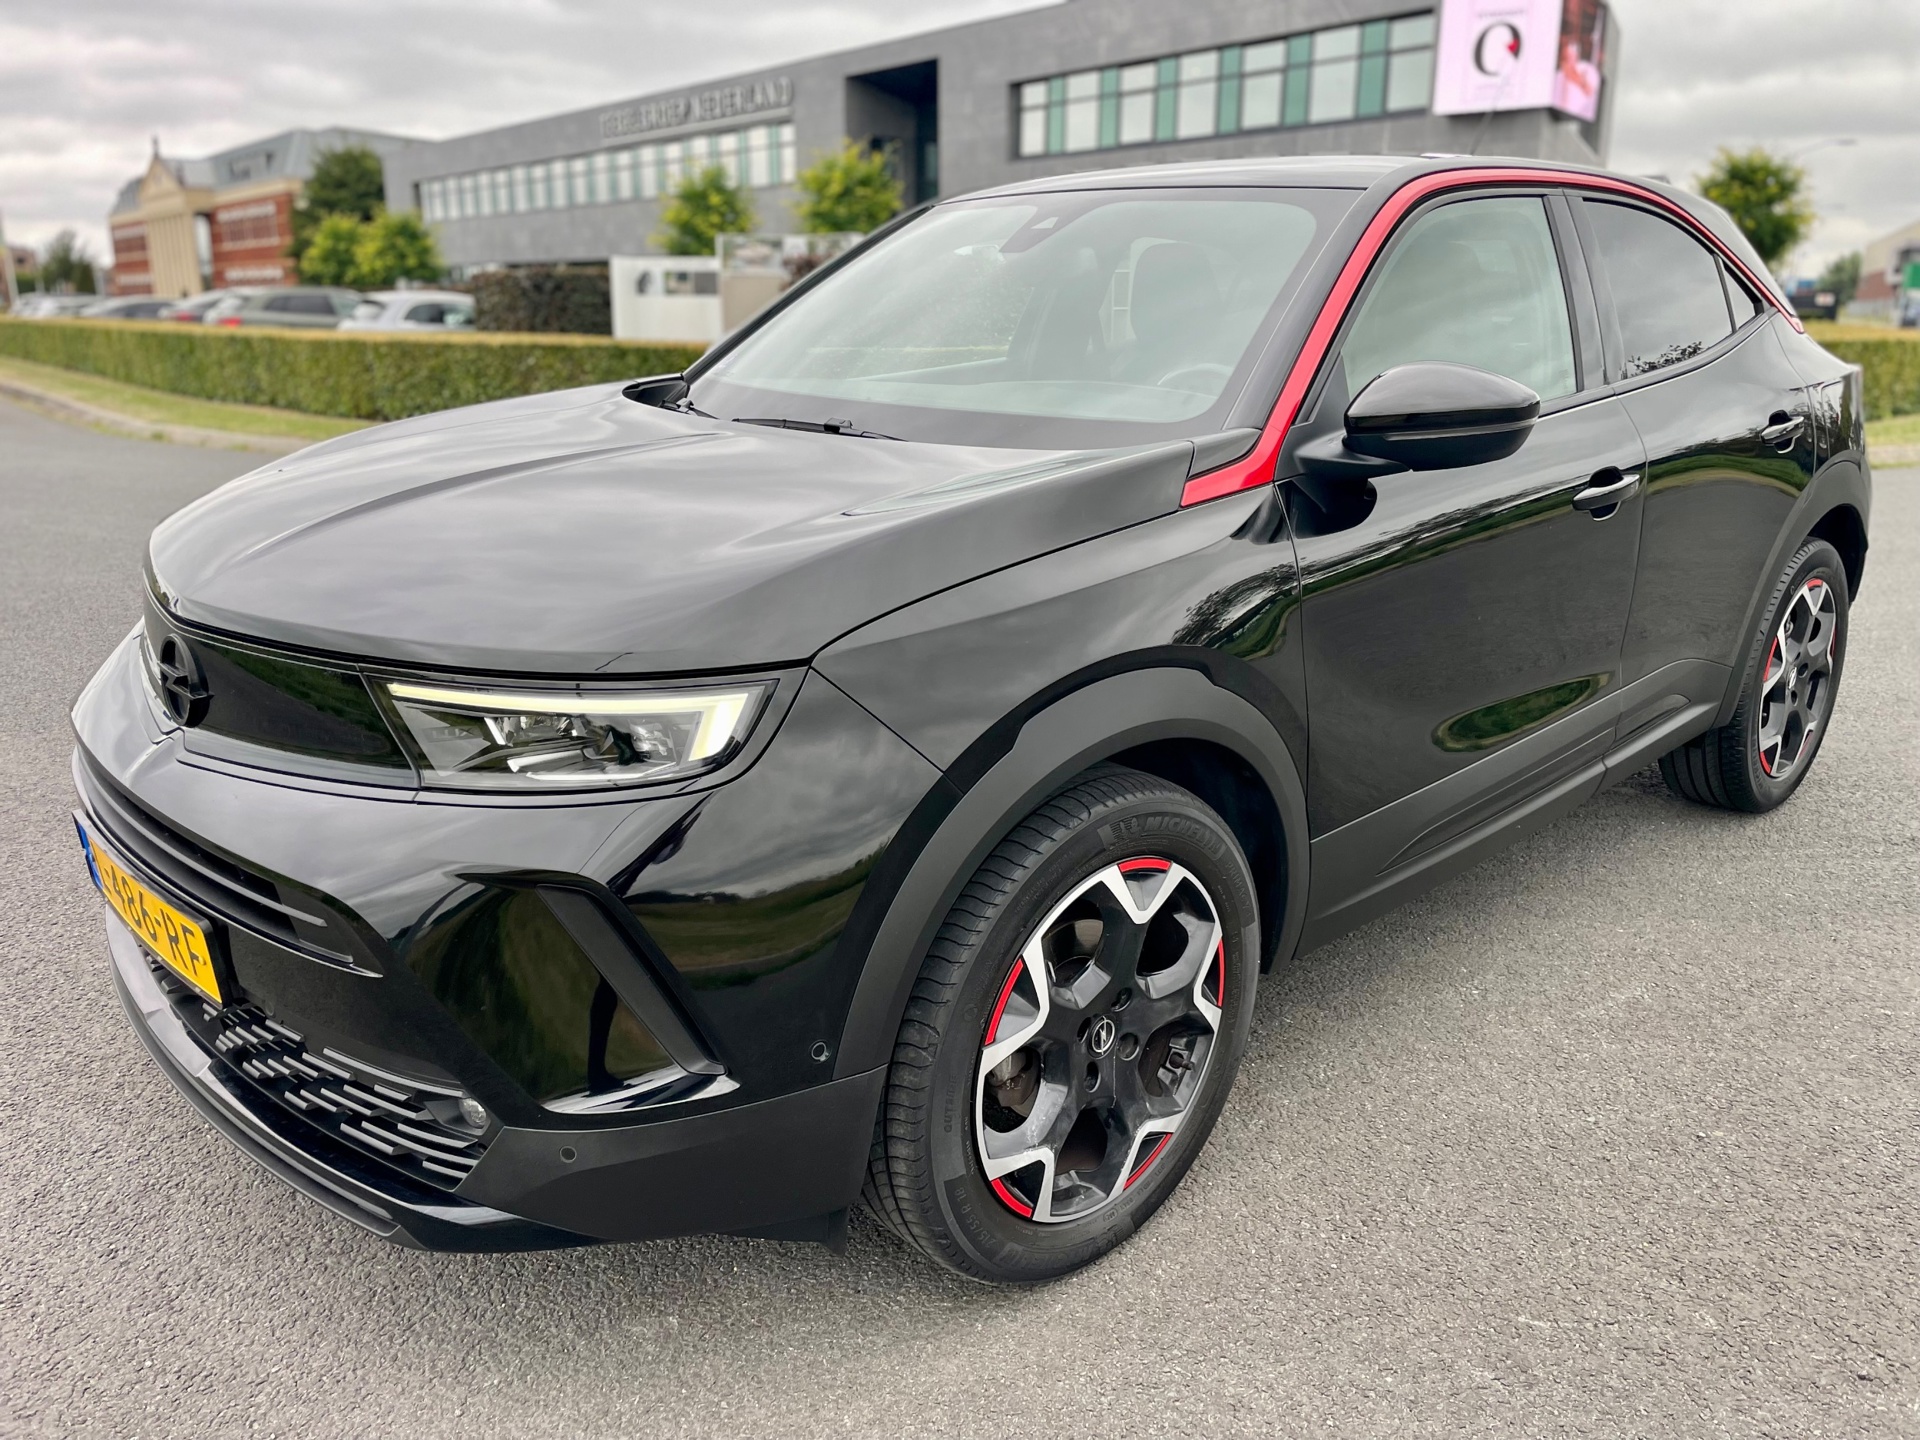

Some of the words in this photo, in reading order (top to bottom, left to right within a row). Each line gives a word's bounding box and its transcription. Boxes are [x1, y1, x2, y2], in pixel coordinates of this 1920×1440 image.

[1144, 816, 1220, 855] MICHELIN
[1226, 862, 1251, 909] PRIMACY
[954, 1186, 964, 1201] 18
[962, 1204, 972, 1213] R
[965, 1214, 996, 1247] 215/55
